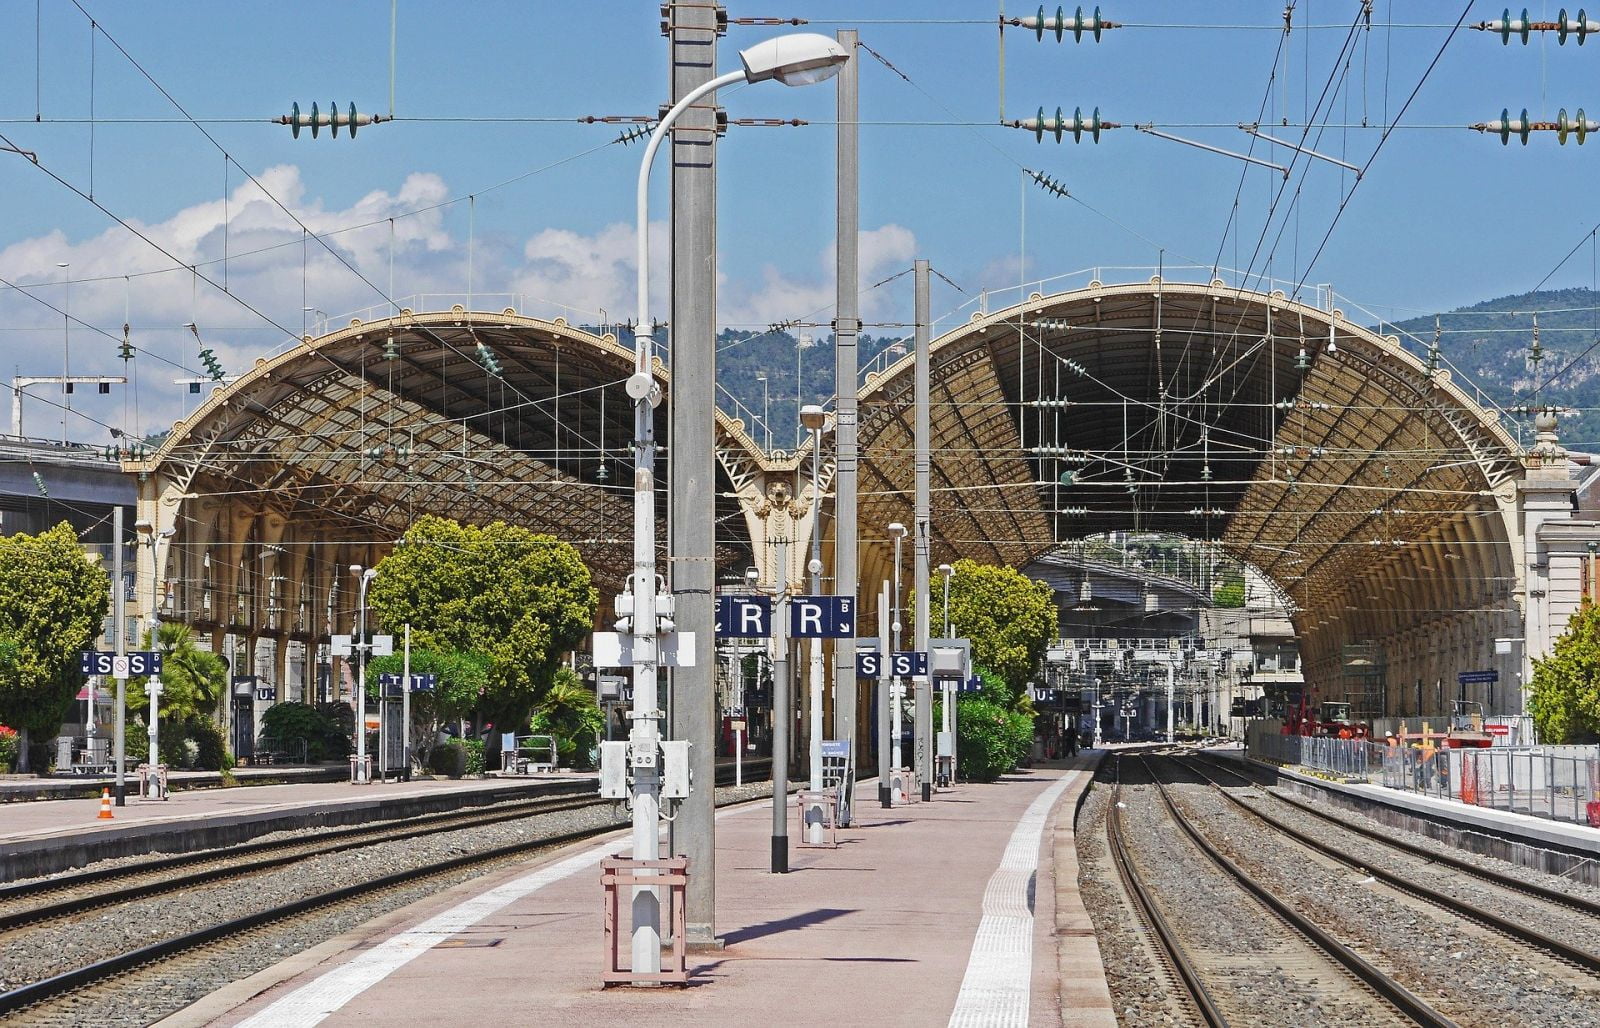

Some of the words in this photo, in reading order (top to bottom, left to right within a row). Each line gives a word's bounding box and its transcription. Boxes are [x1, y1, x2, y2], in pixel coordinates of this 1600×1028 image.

[841, 603, 849, 612] B
[741, 604, 763, 633] R
[801, 604, 822, 633] R
[97, 655, 111, 673] S
[131, 655, 145, 673] S
[862, 656, 876, 674] S
[896, 656, 910, 674] S
[413, 676, 424, 689] T
[260, 690, 268, 700] U
[1037, 691, 1046, 700] U
